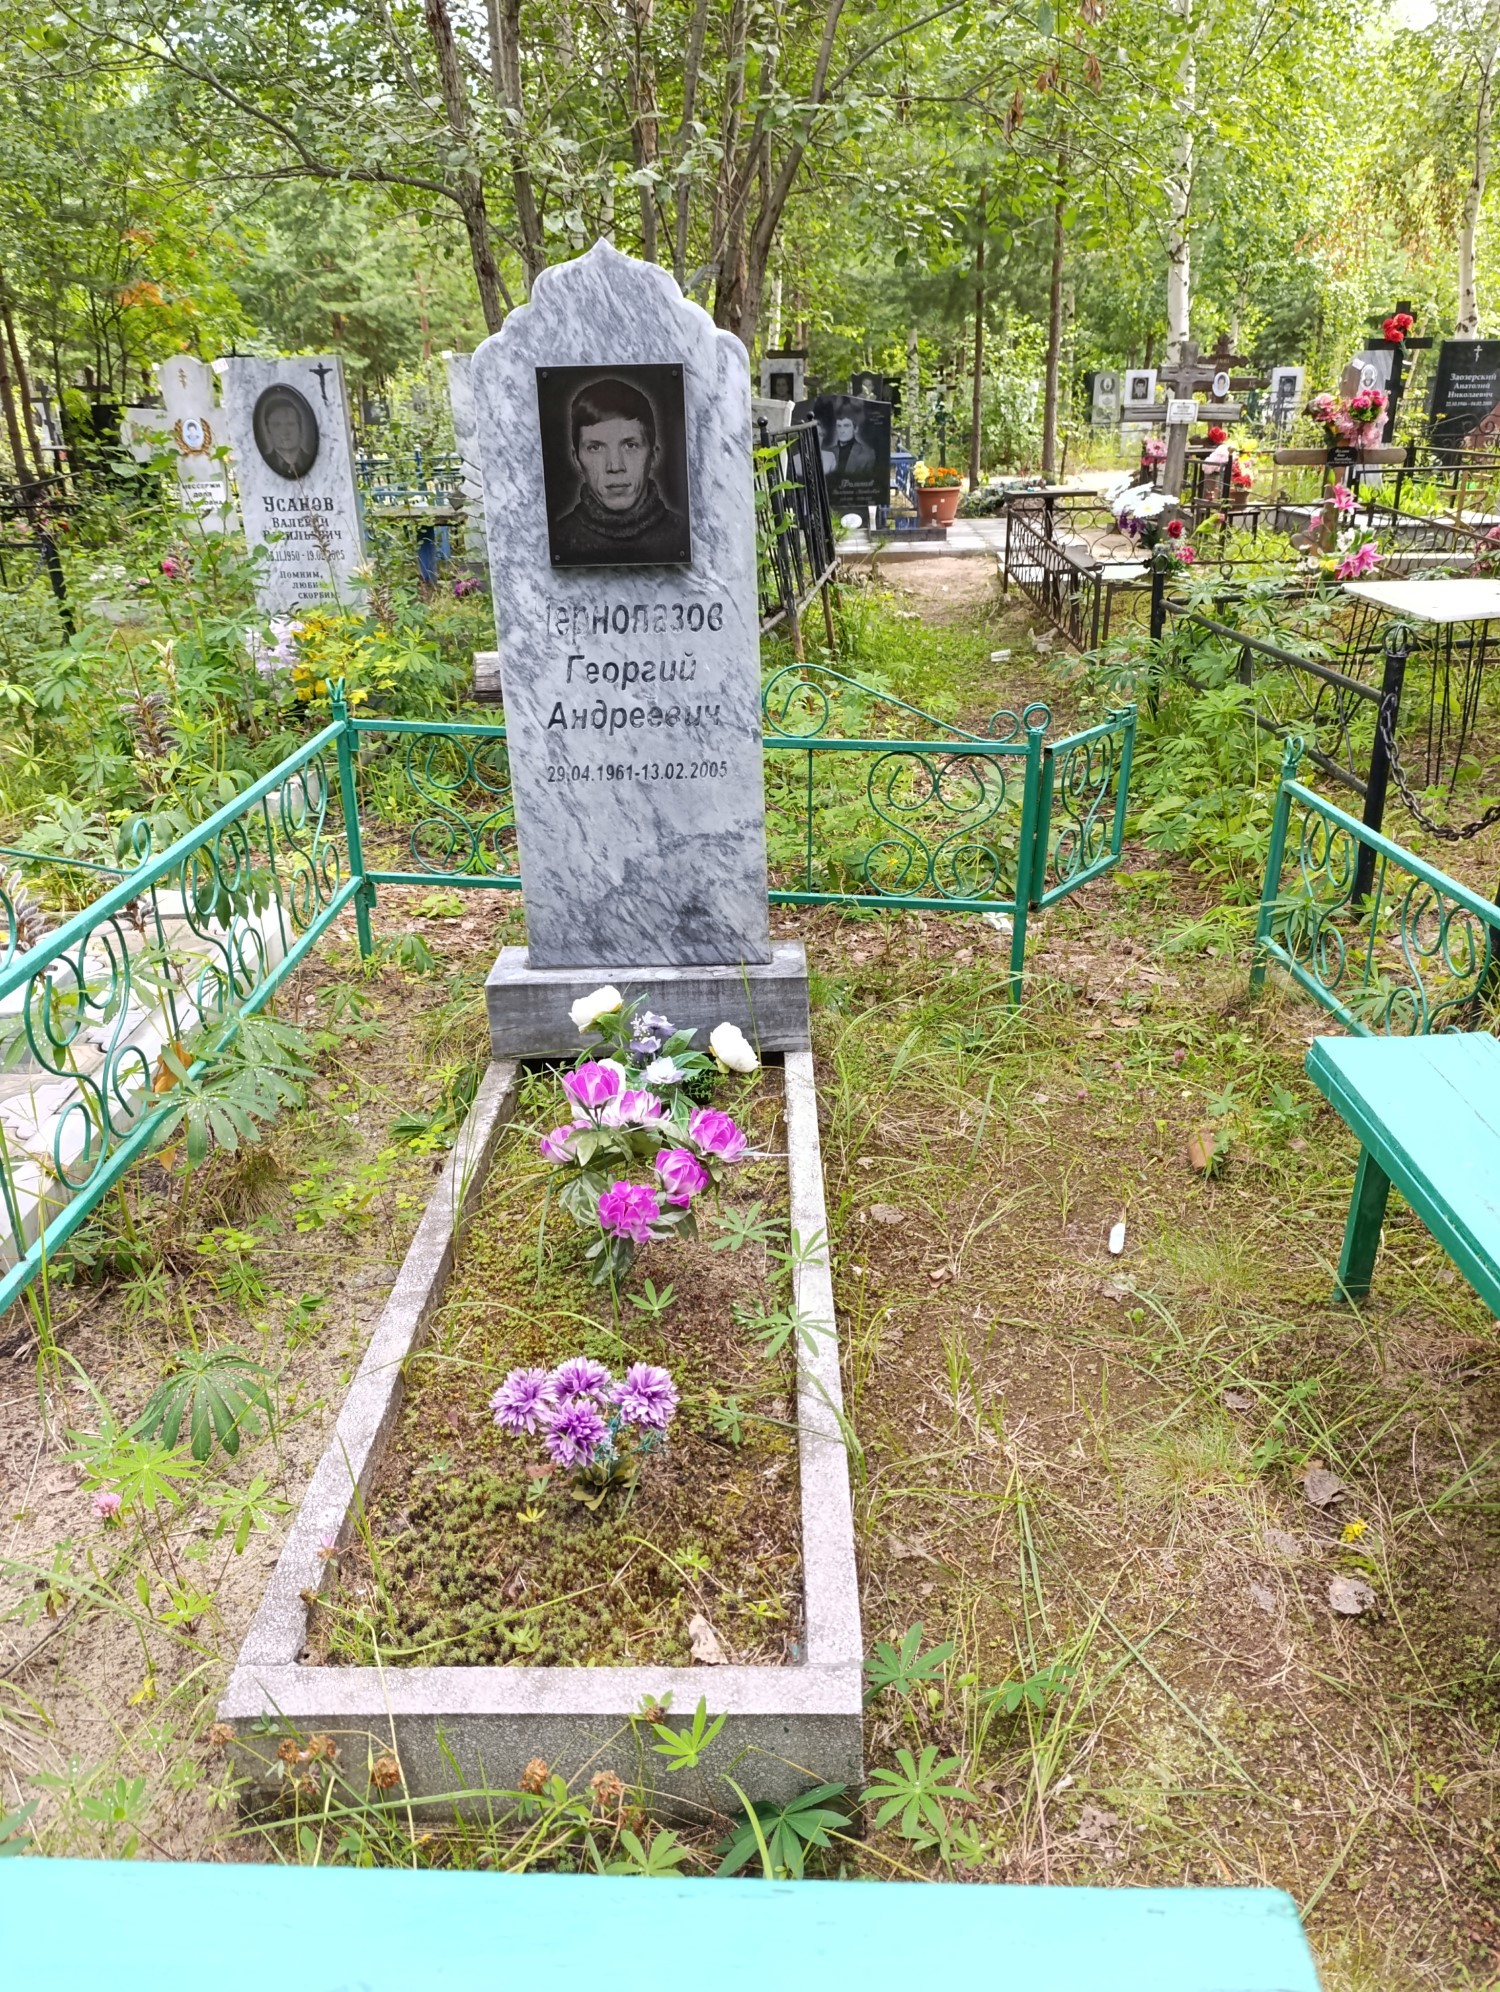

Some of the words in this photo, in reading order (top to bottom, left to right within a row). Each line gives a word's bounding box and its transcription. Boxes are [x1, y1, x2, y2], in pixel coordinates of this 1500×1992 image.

[566, 651, 697, 690] Георгий
[547, 700, 721, 736] Андреевич
[547, 760, 728, 783] 29.04.1961-13.02.2005
